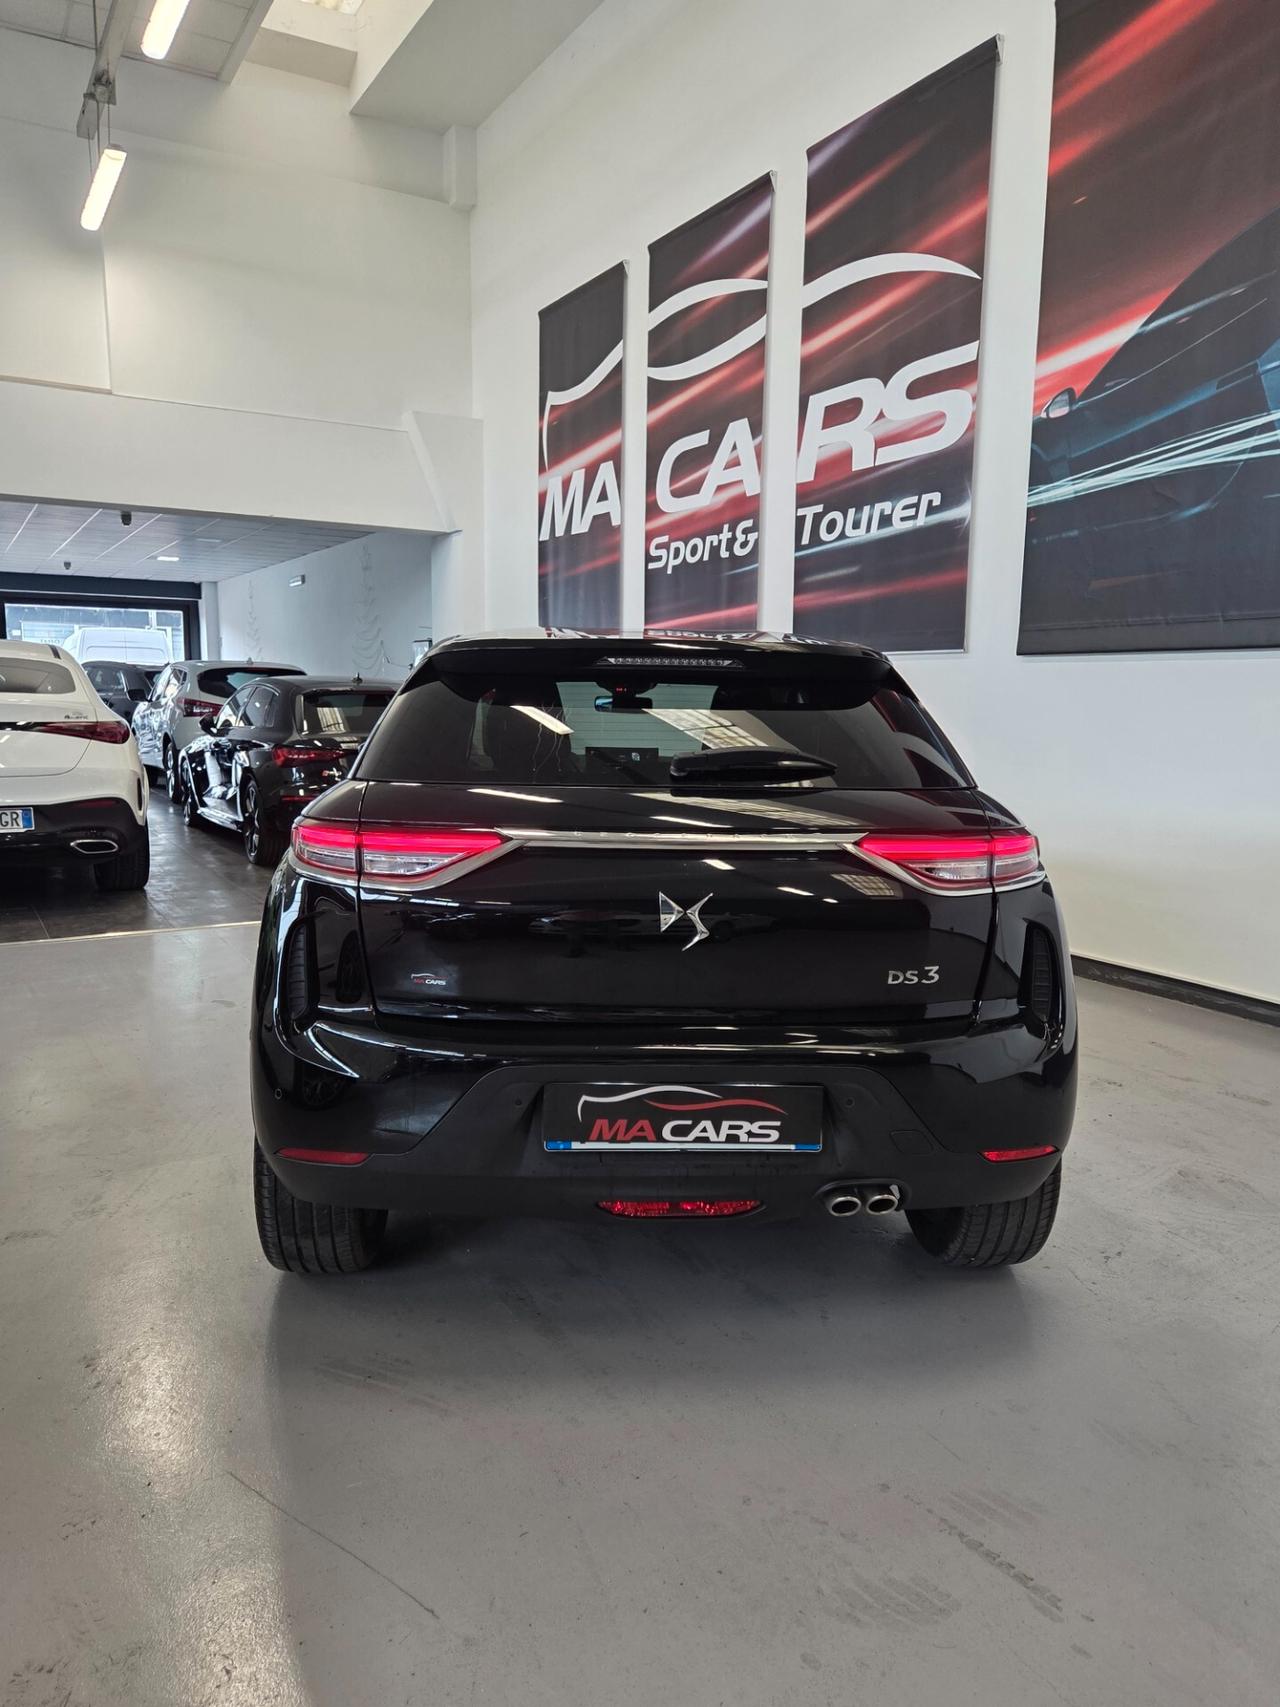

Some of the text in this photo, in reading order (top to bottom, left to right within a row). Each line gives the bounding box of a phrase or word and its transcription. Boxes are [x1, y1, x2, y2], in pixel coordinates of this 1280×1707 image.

[539, 460, 622, 541] MA
[797, 491, 942, 545] Tourer
[588, 1118, 781, 1143] MA CARS
